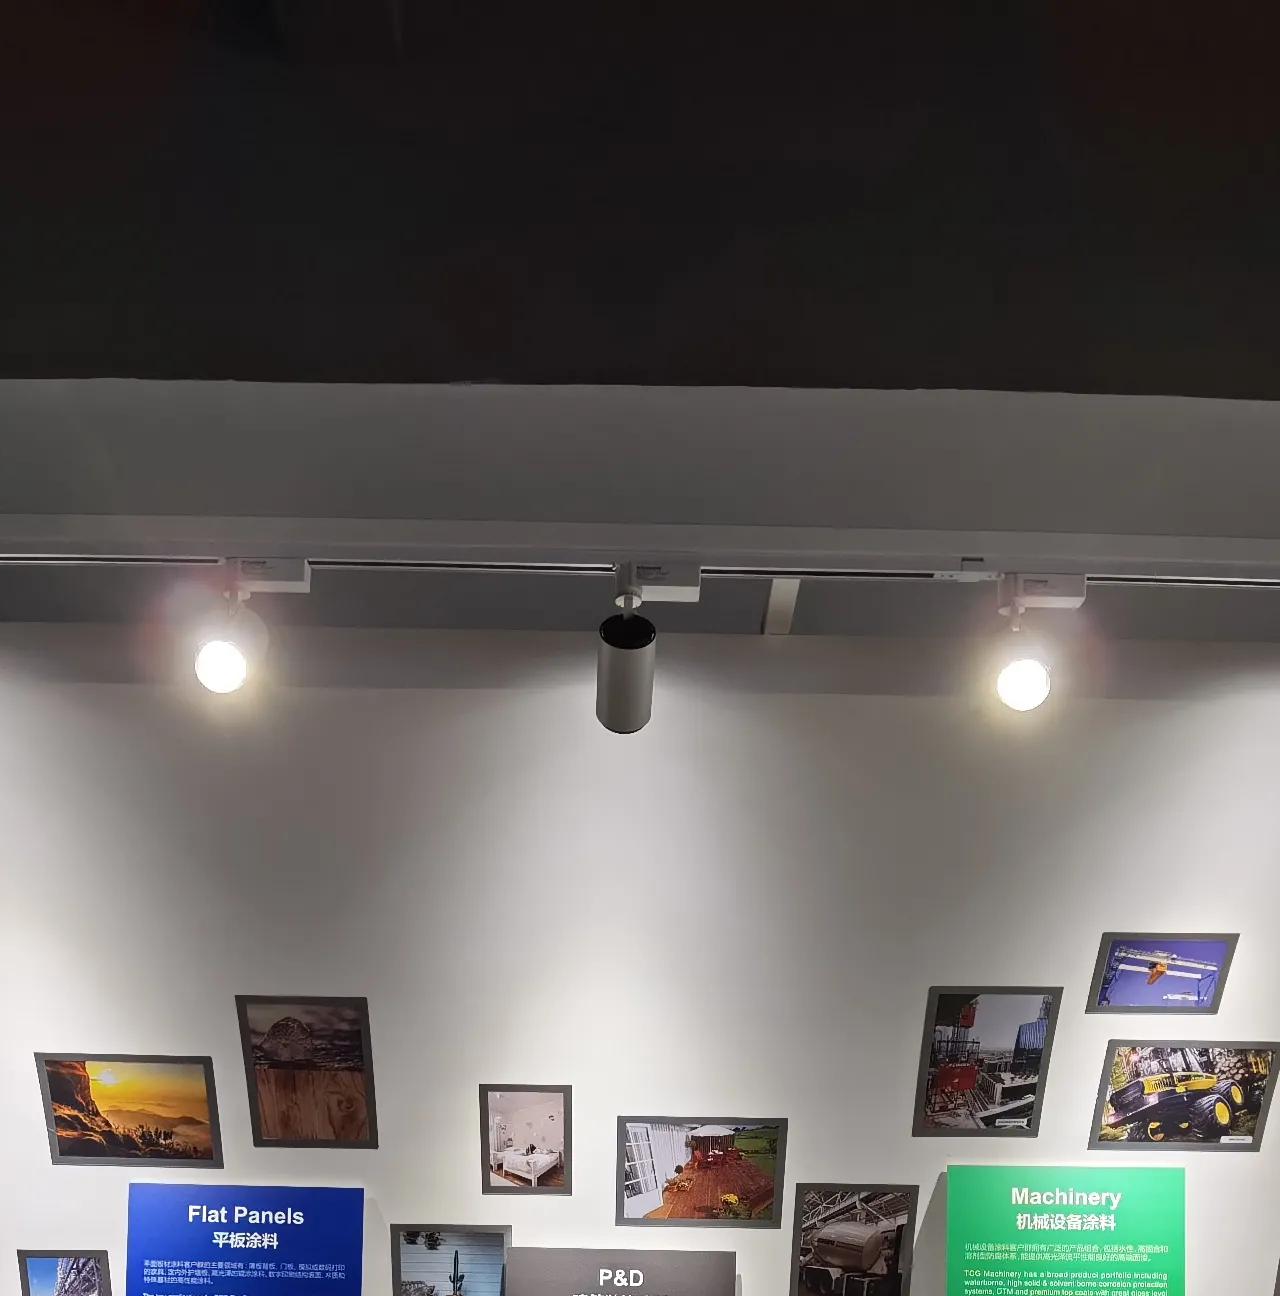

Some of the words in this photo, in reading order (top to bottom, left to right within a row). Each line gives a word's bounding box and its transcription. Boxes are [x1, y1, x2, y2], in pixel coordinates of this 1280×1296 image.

[1011, 1186, 1121, 1210] Machinery
[187, 1204, 228, 1223] Flat
[233, 1205, 304, 1225] Panels
[1015, 1212, 1116, 1231] 机械设备涂料
[211, 1230, 279, 1249] 平板涂料
[598, 1268, 643, 1287] P&D
